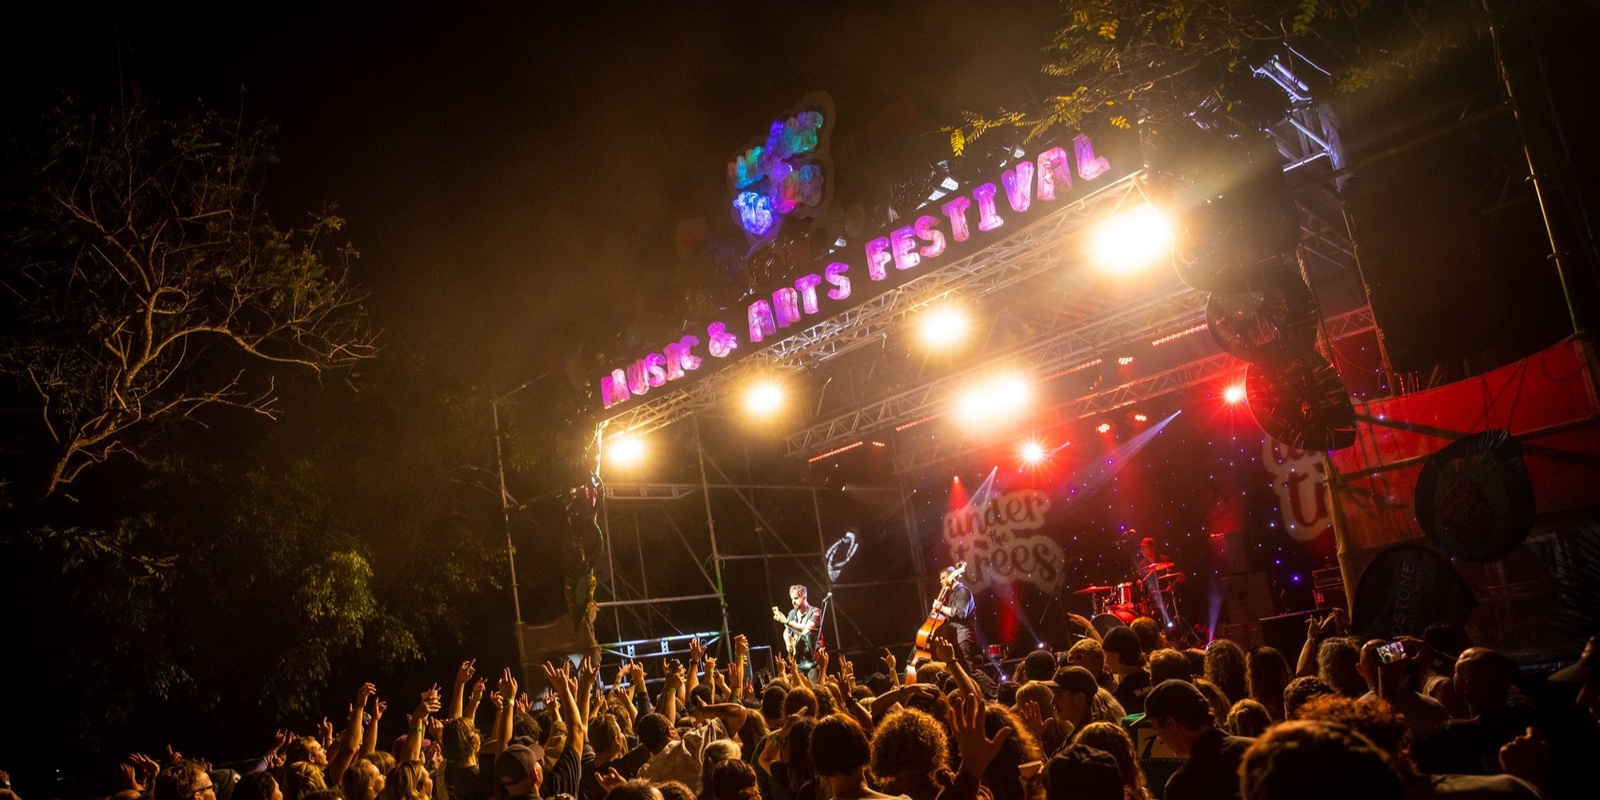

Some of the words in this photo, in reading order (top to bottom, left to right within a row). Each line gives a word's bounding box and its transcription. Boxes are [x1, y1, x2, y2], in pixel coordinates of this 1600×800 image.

[601, 333, 702, 409] MUSIC
[707, 321, 737, 358] &
[747, 261, 852, 343] ARTS
[864, 132, 1111, 281] FESTIVAL
[948, 494, 1044, 539] under
[987, 528, 1010, 547] the
[953, 543, 1057, 585] trees
